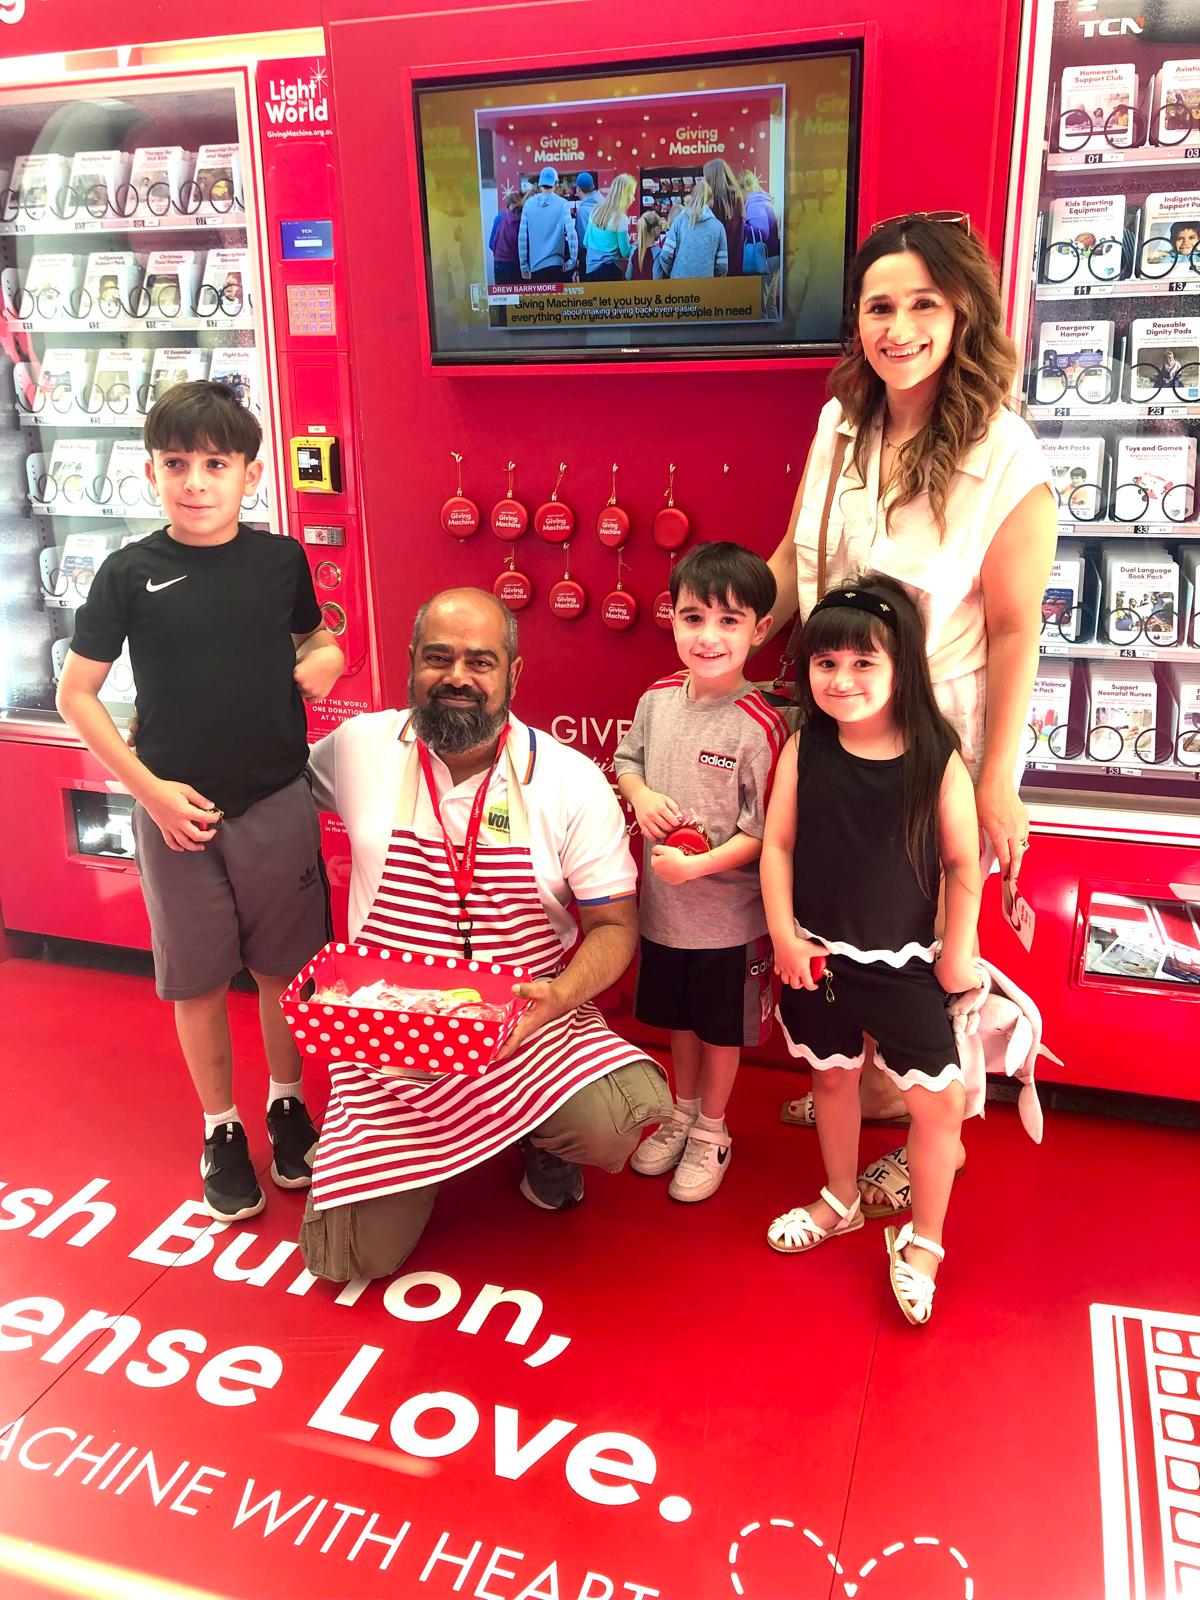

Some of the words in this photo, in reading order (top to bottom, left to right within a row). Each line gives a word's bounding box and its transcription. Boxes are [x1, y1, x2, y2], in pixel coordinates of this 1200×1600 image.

[1079, 16, 1145, 38] TCN
[1080, 68, 1118, 76] Homework
[1075, 76, 1104, 84] Support
[270, 78, 317, 106] Light
[265, 98, 328, 124] World
[676, 125, 719, 142] Giving
[540, 134, 579, 150] Giving
[669, 141, 725, 155] Machine
[534, 149, 585, 163] Machine
[1088, 154, 1100, 163] 01
[1065, 199, 1080, 207] Kids
[1082, 199, 1114, 208] Sporting
[1159, 202, 1189, 210] Support
[1069, 207, 1108, 215] Equipment
[492, 286, 513, 294] DREW
[514, 284, 557, 293] BARRYMORE
[1077, 287, 1088, 295] 11
[1172, 283, 1184, 291] 13
[599, 297, 612, 307] let
[613, 298, 632, 309] you
[634, 295, 653, 306] buy
[655, 294, 662, 304] &
[665, 294, 701, 304] donate
[511, 312, 561, 324] everything
[726, 305, 753, 316] need
[1056, 324, 1094, 332] Emergency
[1152, 321, 1186, 329] Reusable
[1146, 328, 1172, 337] Dignity
[1174, 327, 1192, 335] Pads
[1057, 408, 1068, 416] 21
[1150, 407, 1162, 415] 23
[451, 513, 471, 521] Giving
[499, 514, 518, 522] Giving
[496, 520, 521, 528] Machine
[545, 517, 566, 526] Giving
[602, 521, 618, 529] Giving
[1137, 525, 1149, 534] 33
[1138, 566, 1172, 575] Language
[503, 587, 523, 595] Giving
[557, 596, 576, 604] Giving
[608, 606, 627, 614] Giving
[605, 612, 630, 620] Machine
[1111, 683, 1139, 691] Support
[343, 700, 368, 708] WORLD
[0, 1177, 117, 1248] sh
[128, 1199, 572, 1368] Buon,
[306, 1344, 693, 1523] Love.
[232, 1478, 412, 1571] WITH
